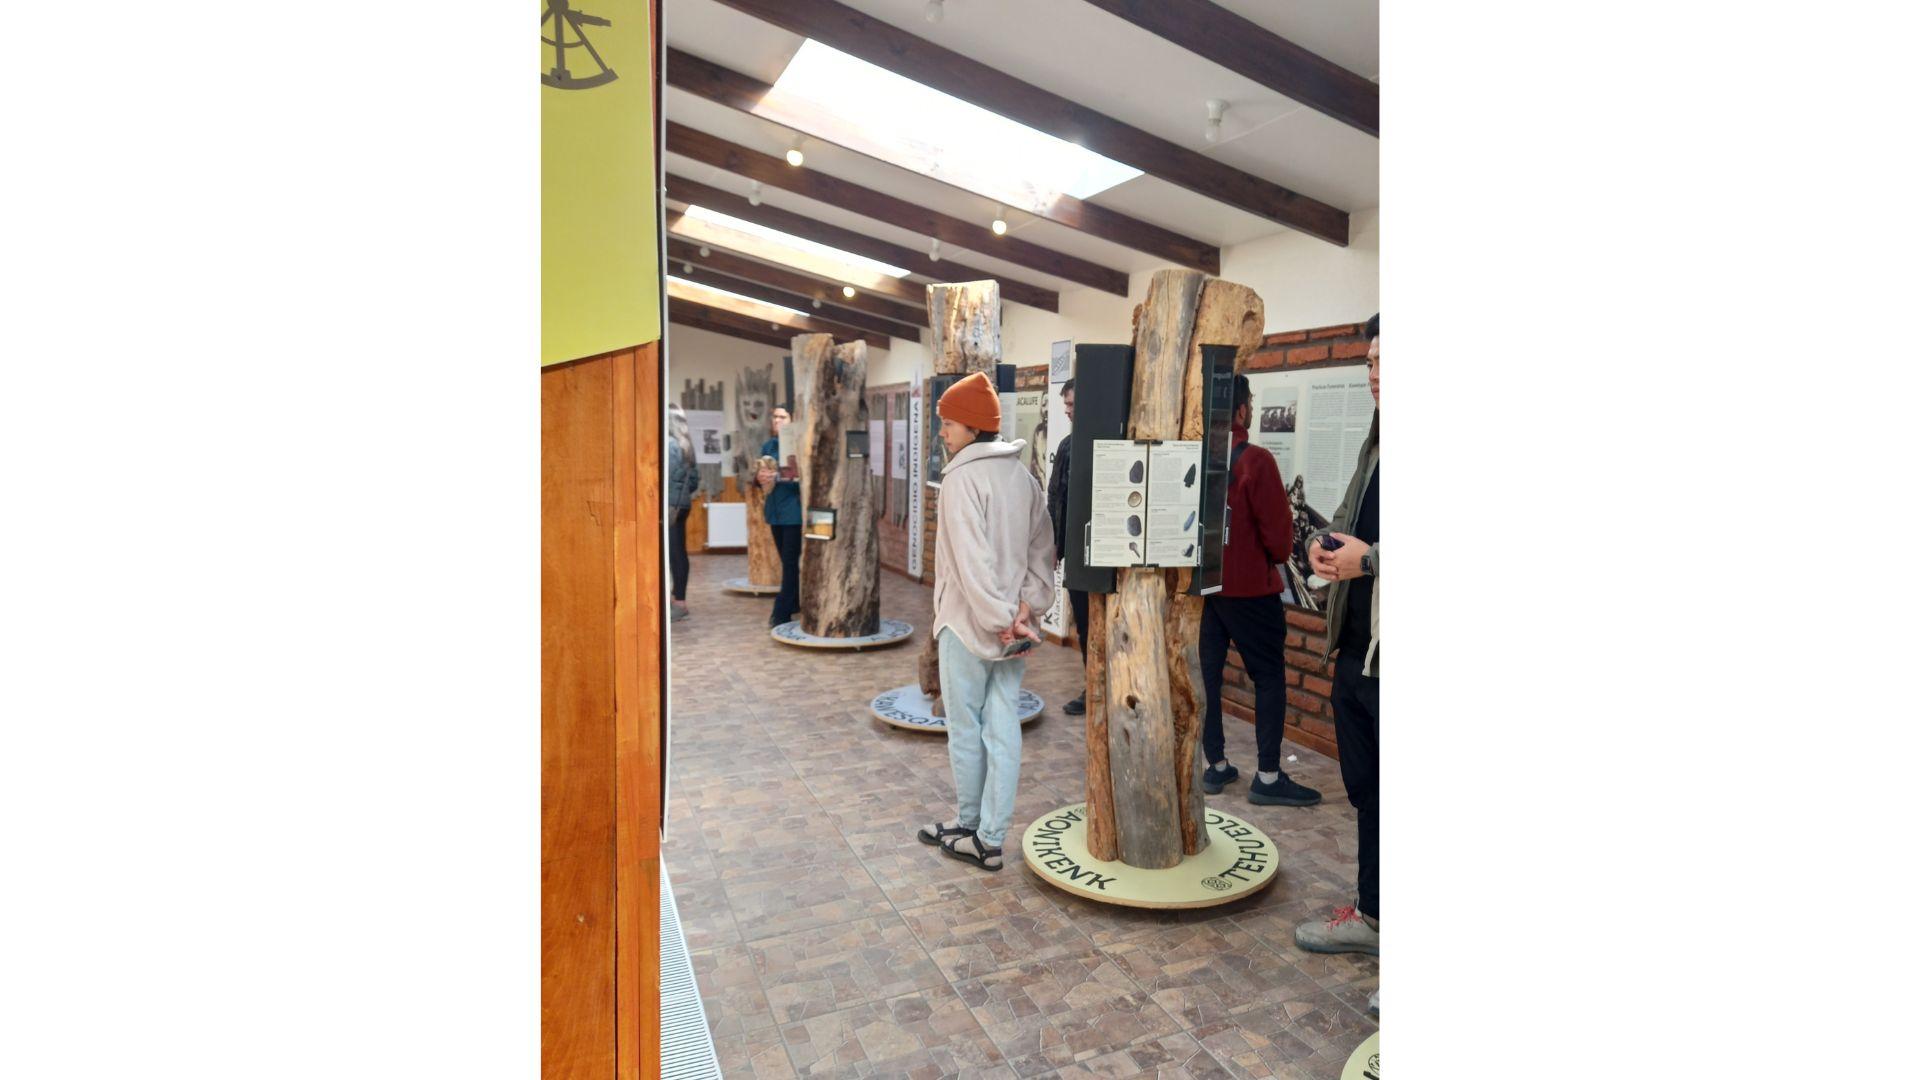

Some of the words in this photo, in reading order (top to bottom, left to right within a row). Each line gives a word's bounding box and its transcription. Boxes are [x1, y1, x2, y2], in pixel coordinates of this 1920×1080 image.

[911, 482, 919, 571] GENOCIDIO
[874, 695, 947, 727] KAWESQA
[1032, 810, 1118, 890] AONIKENK
[1206, 813, 1269, 882] TEHUELC
